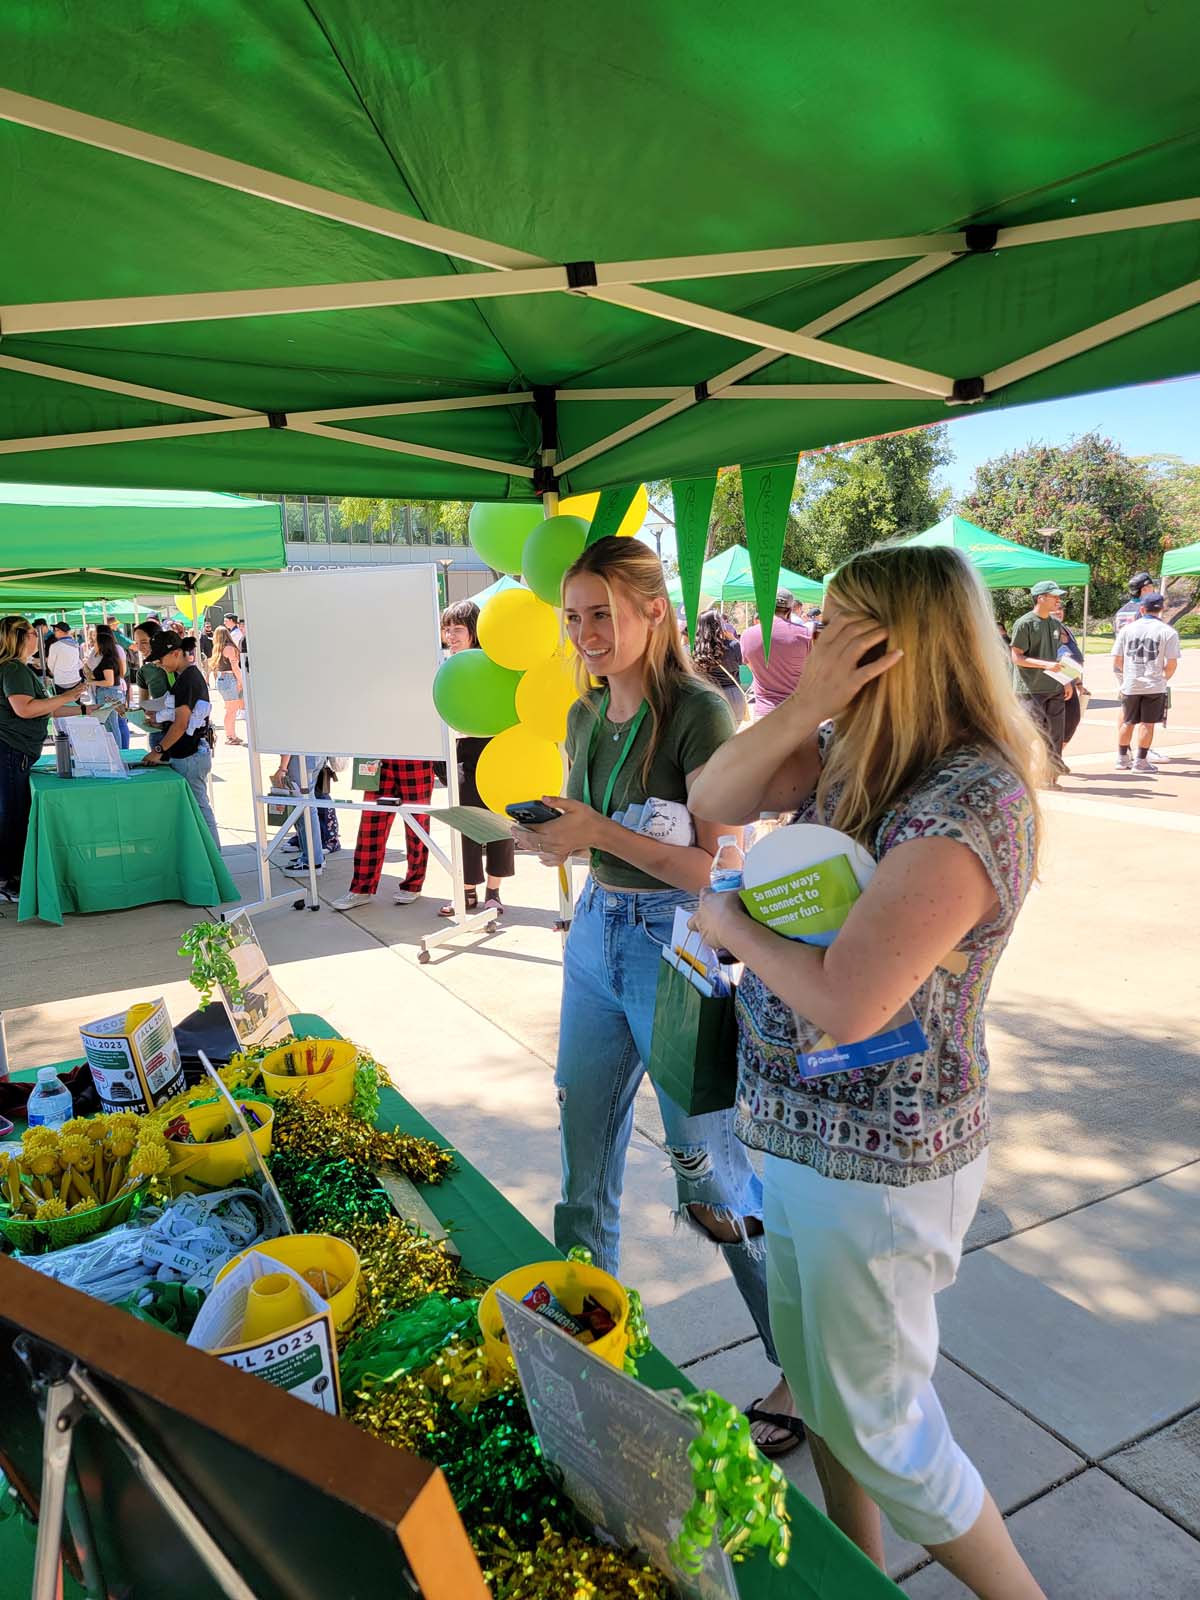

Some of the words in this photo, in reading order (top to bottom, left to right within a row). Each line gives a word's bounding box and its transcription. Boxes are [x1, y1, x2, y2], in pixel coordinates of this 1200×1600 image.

[753, 891, 765, 902] So
[765, 883, 790, 899] many
[790, 872, 821, 890] ways
[760, 905, 770, 915] to
[769, 894, 806, 913] connect
[805, 889, 820, 900] to
[800, 905, 824, 919] fun.
[98, 1041, 122, 1049] 2023
[173, 1254, 200, 1272] LET'S
[264, 1331, 314, 1362] 2023
